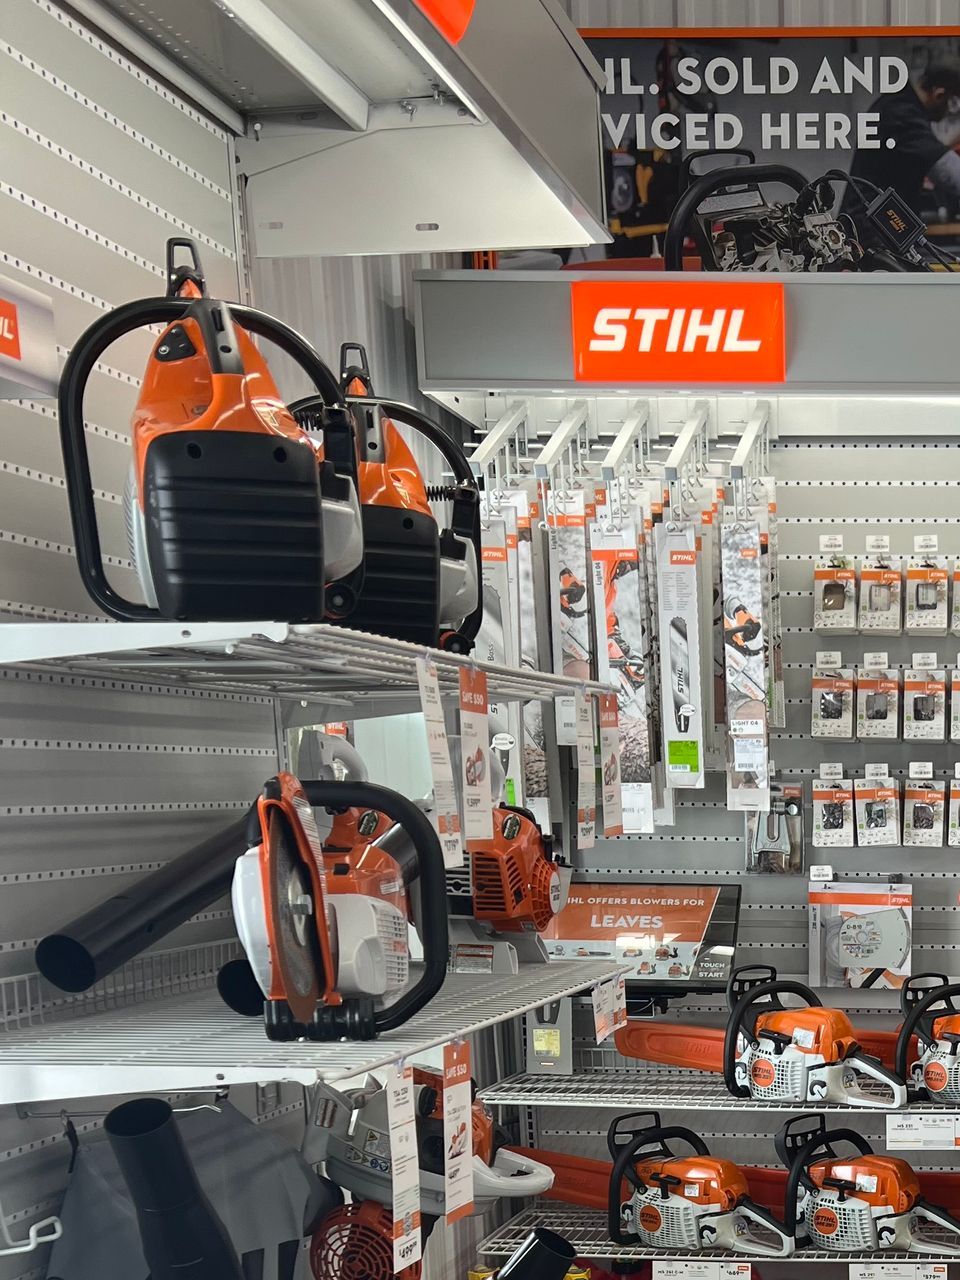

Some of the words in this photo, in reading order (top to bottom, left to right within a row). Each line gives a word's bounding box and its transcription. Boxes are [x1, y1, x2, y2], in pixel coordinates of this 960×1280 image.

[676, 57, 799, 95] SOLD
[810, 57, 909, 95] AND
[761, 112, 896, 150] HERE.
[589, 307, 762, 352] STIHL
[587, 897, 627, 905] OFFERS
[630, 898, 680, 906] BLOWERS
[590, 914, 663, 929] LEAVES
[753, 1066, 774, 1074] STIHL
[814, 1215, 836, 1223] STIHL
